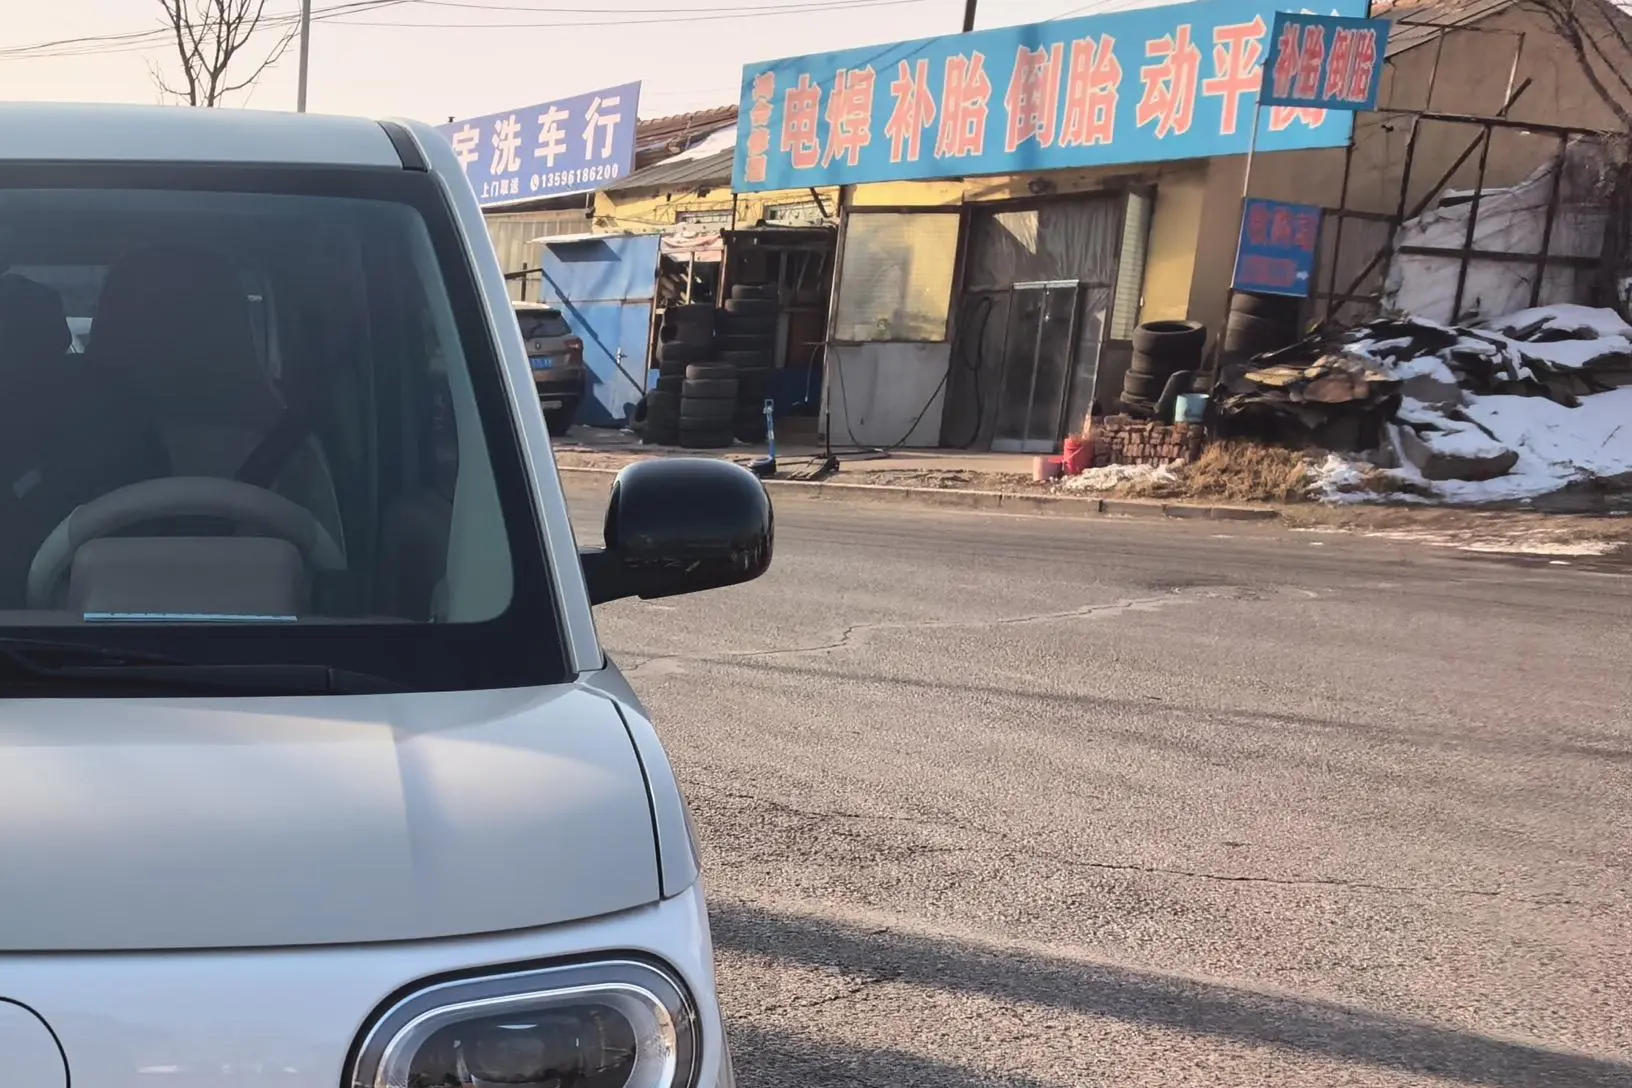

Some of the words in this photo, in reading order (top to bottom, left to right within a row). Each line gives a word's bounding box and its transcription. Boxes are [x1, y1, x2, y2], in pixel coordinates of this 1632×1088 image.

[780, 64, 875, 169] 电焊
[884, 49, 992, 163] 补胎
[1004, 32, 1122, 154] 倒胎
[542, 163, 619, 187] 13596186200
